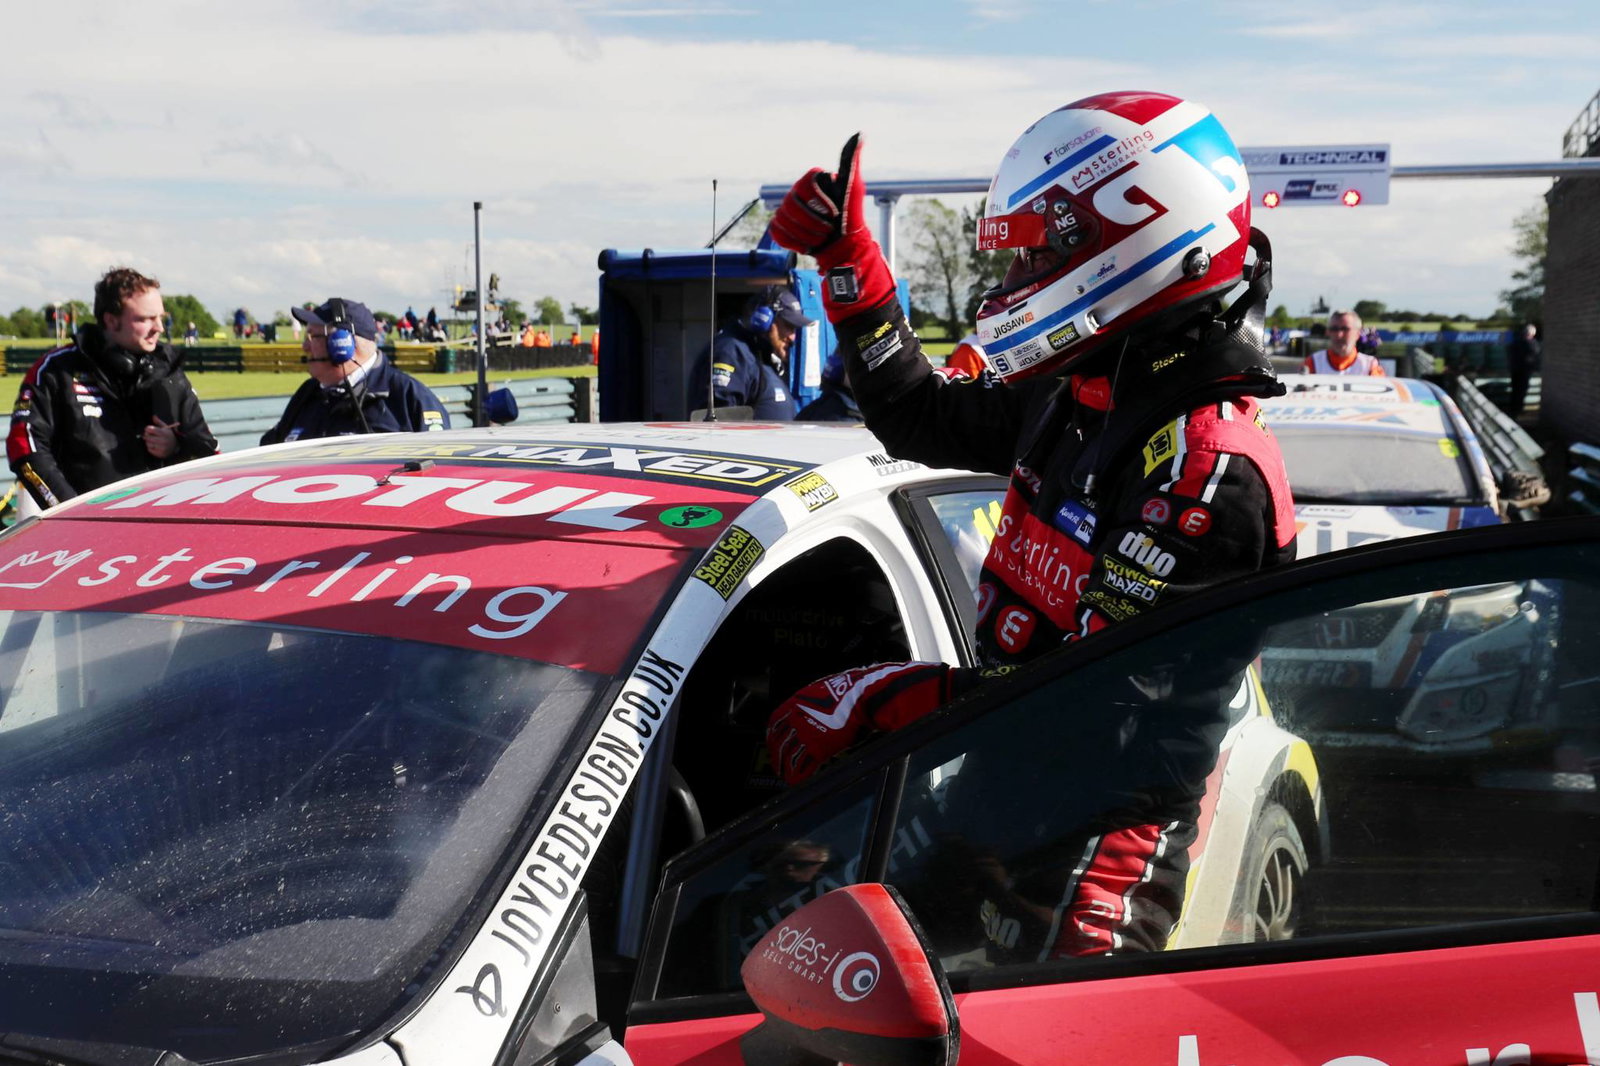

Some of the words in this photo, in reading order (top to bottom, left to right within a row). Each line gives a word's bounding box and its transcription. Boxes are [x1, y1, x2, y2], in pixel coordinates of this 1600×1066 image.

[1091, 130, 1154, 169] sterling
[1096, 144, 1149, 177] INSURANCE
[1284, 151, 1382, 165] TECHNICAL
[979, 219, 1009, 241] ling
[1054, 212, 1077, 231] NG
[104, 474, 657, 531] MOTUL
[695, 549, 734, 585] Steel
[718, 526, 751, 556] Seal
[716, 575, 737, 598] HEAD
[731, 549, 753, 577] GASKET
[748, 539, 762, 558] FIX
[1118, 531, 1177, 578] duo
[78, 547, 569, 640] sterling
[491, 649, 686, 968] JOYCEDESIGN.CO.UK
[762, 949, 783, 965] SELL
[787, 960, 823, 985] SMART
[770, 926, 844, 974] sales-i
